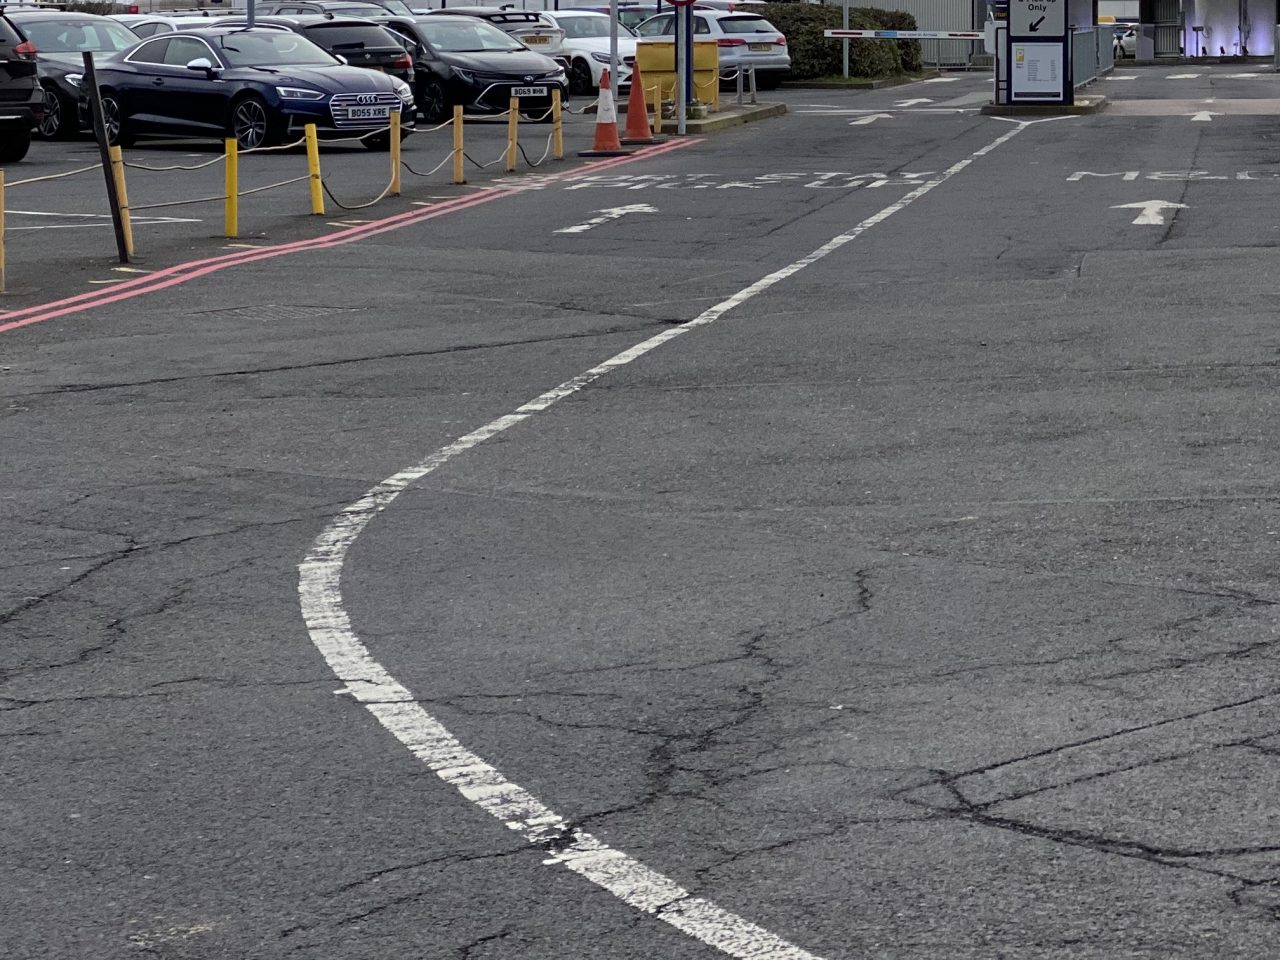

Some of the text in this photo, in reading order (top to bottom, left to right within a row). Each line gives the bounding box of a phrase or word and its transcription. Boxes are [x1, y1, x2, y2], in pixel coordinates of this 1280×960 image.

[1028, 3, 1047, 12] Only
[755, 171, 936, 181] STAY
[562, 181, 781, 190] PICK
[803, 179, 929, 189] UP
